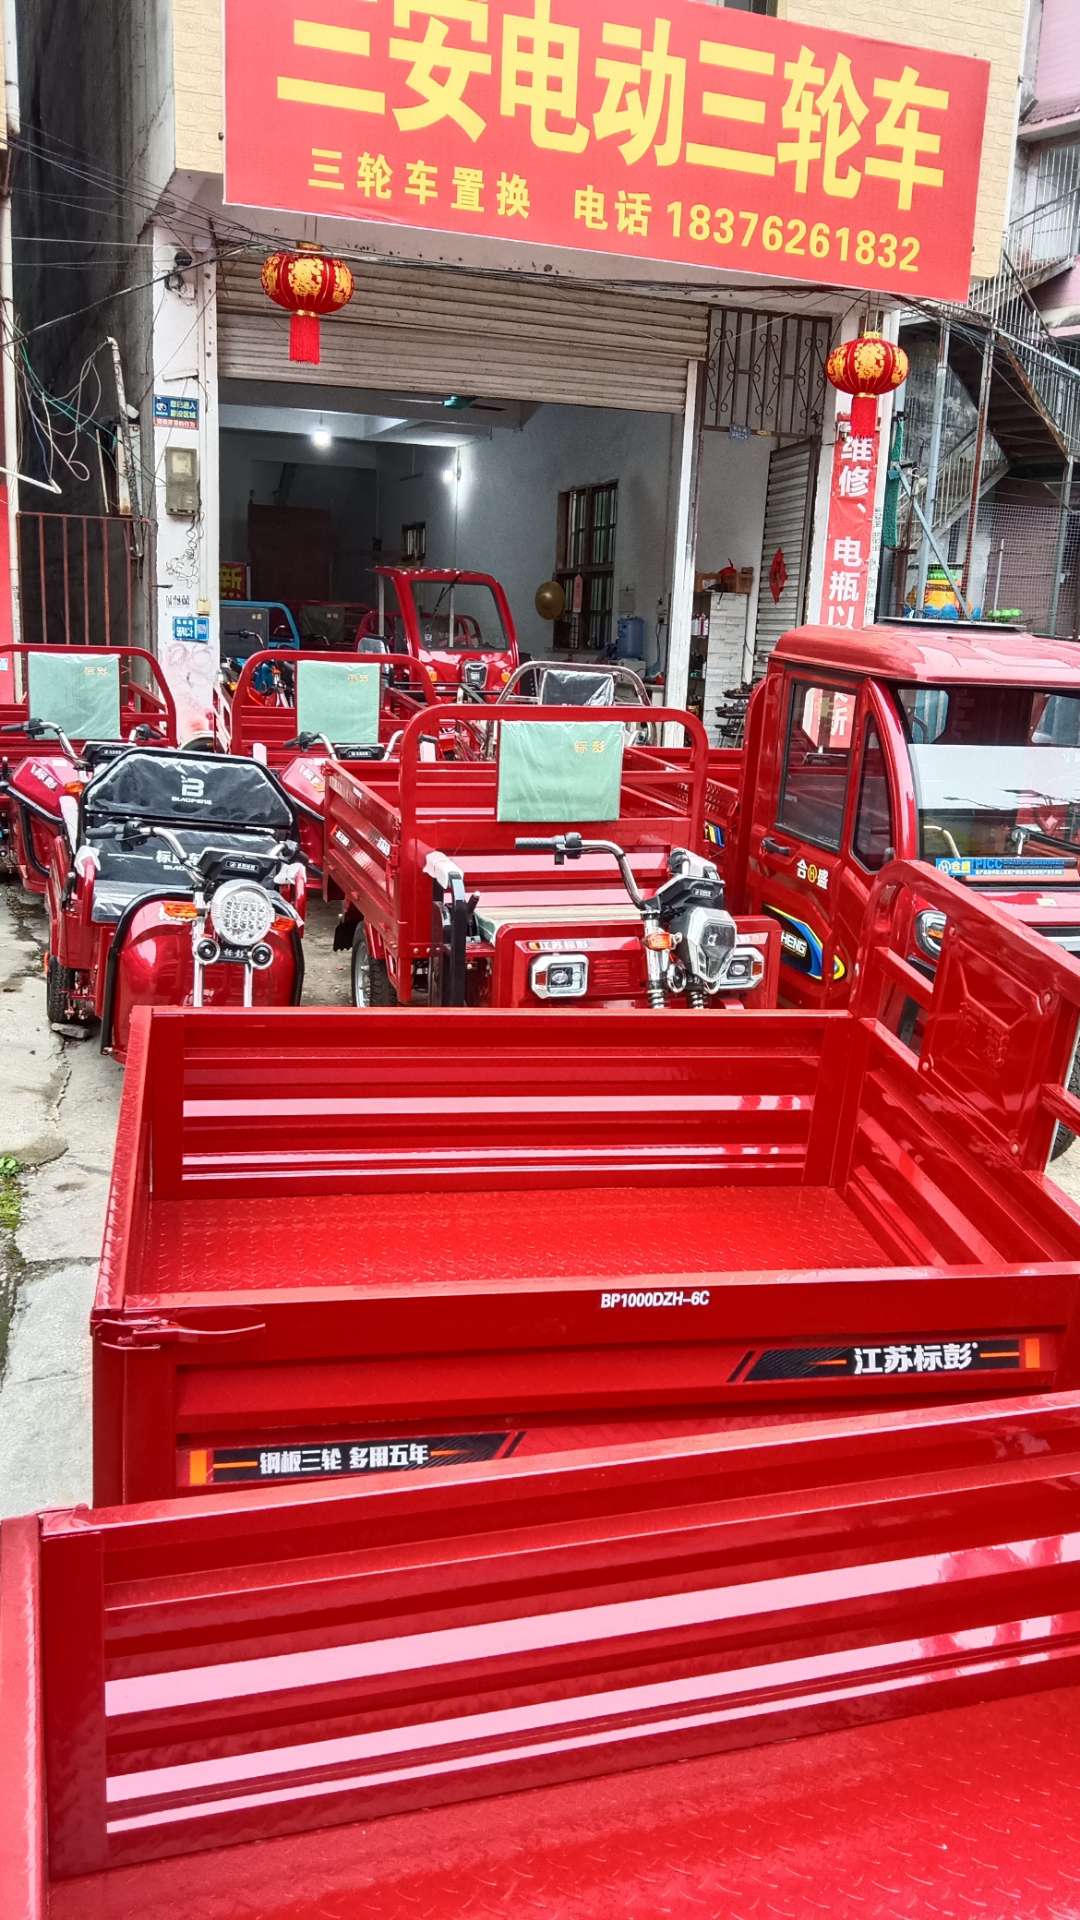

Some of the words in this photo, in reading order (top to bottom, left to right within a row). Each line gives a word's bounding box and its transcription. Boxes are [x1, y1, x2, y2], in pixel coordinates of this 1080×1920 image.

[277, 0, 949, 210] 三安电动三轮车
[309, 147, 531, 219] 三轮车置换
[574, 185, 652, 237] 电话
[667, 201, 920, 272] 18376261832
[600, 1290, 711, 1309] BP1000DZH-6C
[853, 1343, 973, 1375] 江苏标彭
[259, 1448, 342, 1475] 钢板三轮
[349, 1443, 429, 1469] 多用五年
